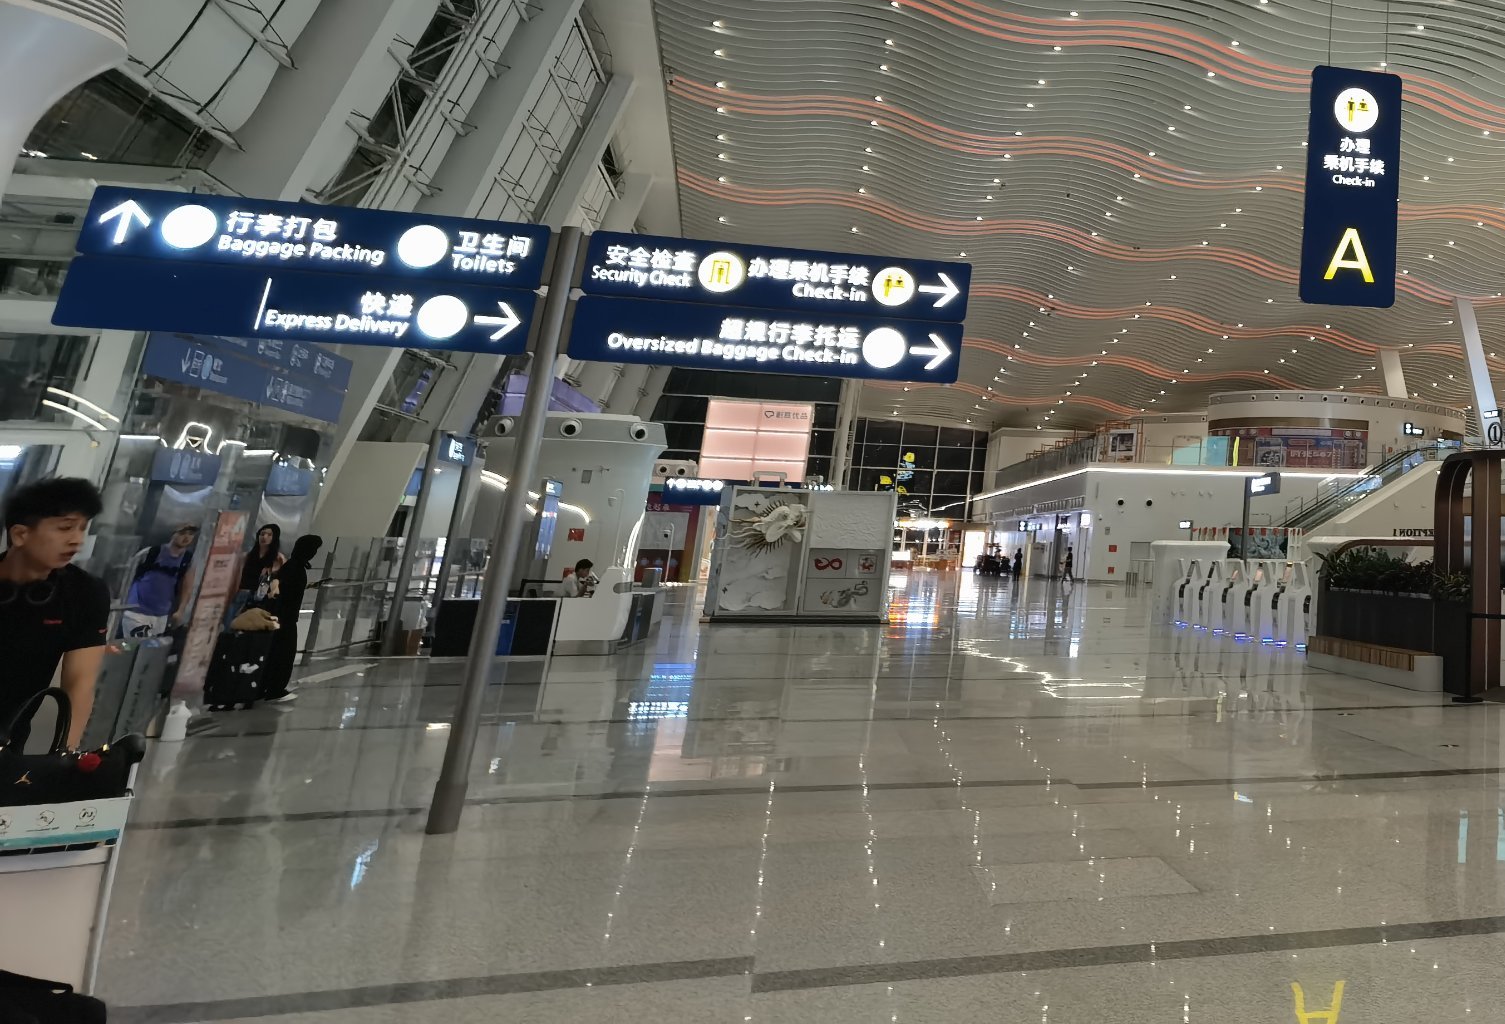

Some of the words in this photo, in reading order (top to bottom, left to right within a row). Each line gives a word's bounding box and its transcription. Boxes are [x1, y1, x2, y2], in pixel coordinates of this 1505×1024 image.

[1340, 137, 1371, 154] 办理
[1323, 155, 1385, 175] 乘机手续
[1332, 175, 1375, 187] Check-in
[226, 210, 337, 241] 行李打包
[217, 234, 305, 259] Baggage
[310, 242, 386, 266] Packing
[456, 230, 530, 257] 卫生间
[1323, 227, 1375, 283] A
[452, 253, 516, 274] Toilets
[605, 244, 697, 272] 安全检查
[591, 264, 647, 288] Security
[649, 270, 692, 288] Check
[747, 257, 870, 287] 办理乘机手续
[361, 290, 414, 317] 快递
[792, 281, 866, 303] Check-in
[264, 308, 334, 331] Express
[335, 313, 410, 337] Delivery
[719, 317, 862, 350] 超规行李托运
[606, 332, 698, 356] Oversized
[700, 339, 780, 362] Baggage
[781, 345, 858, 366] Check-in
